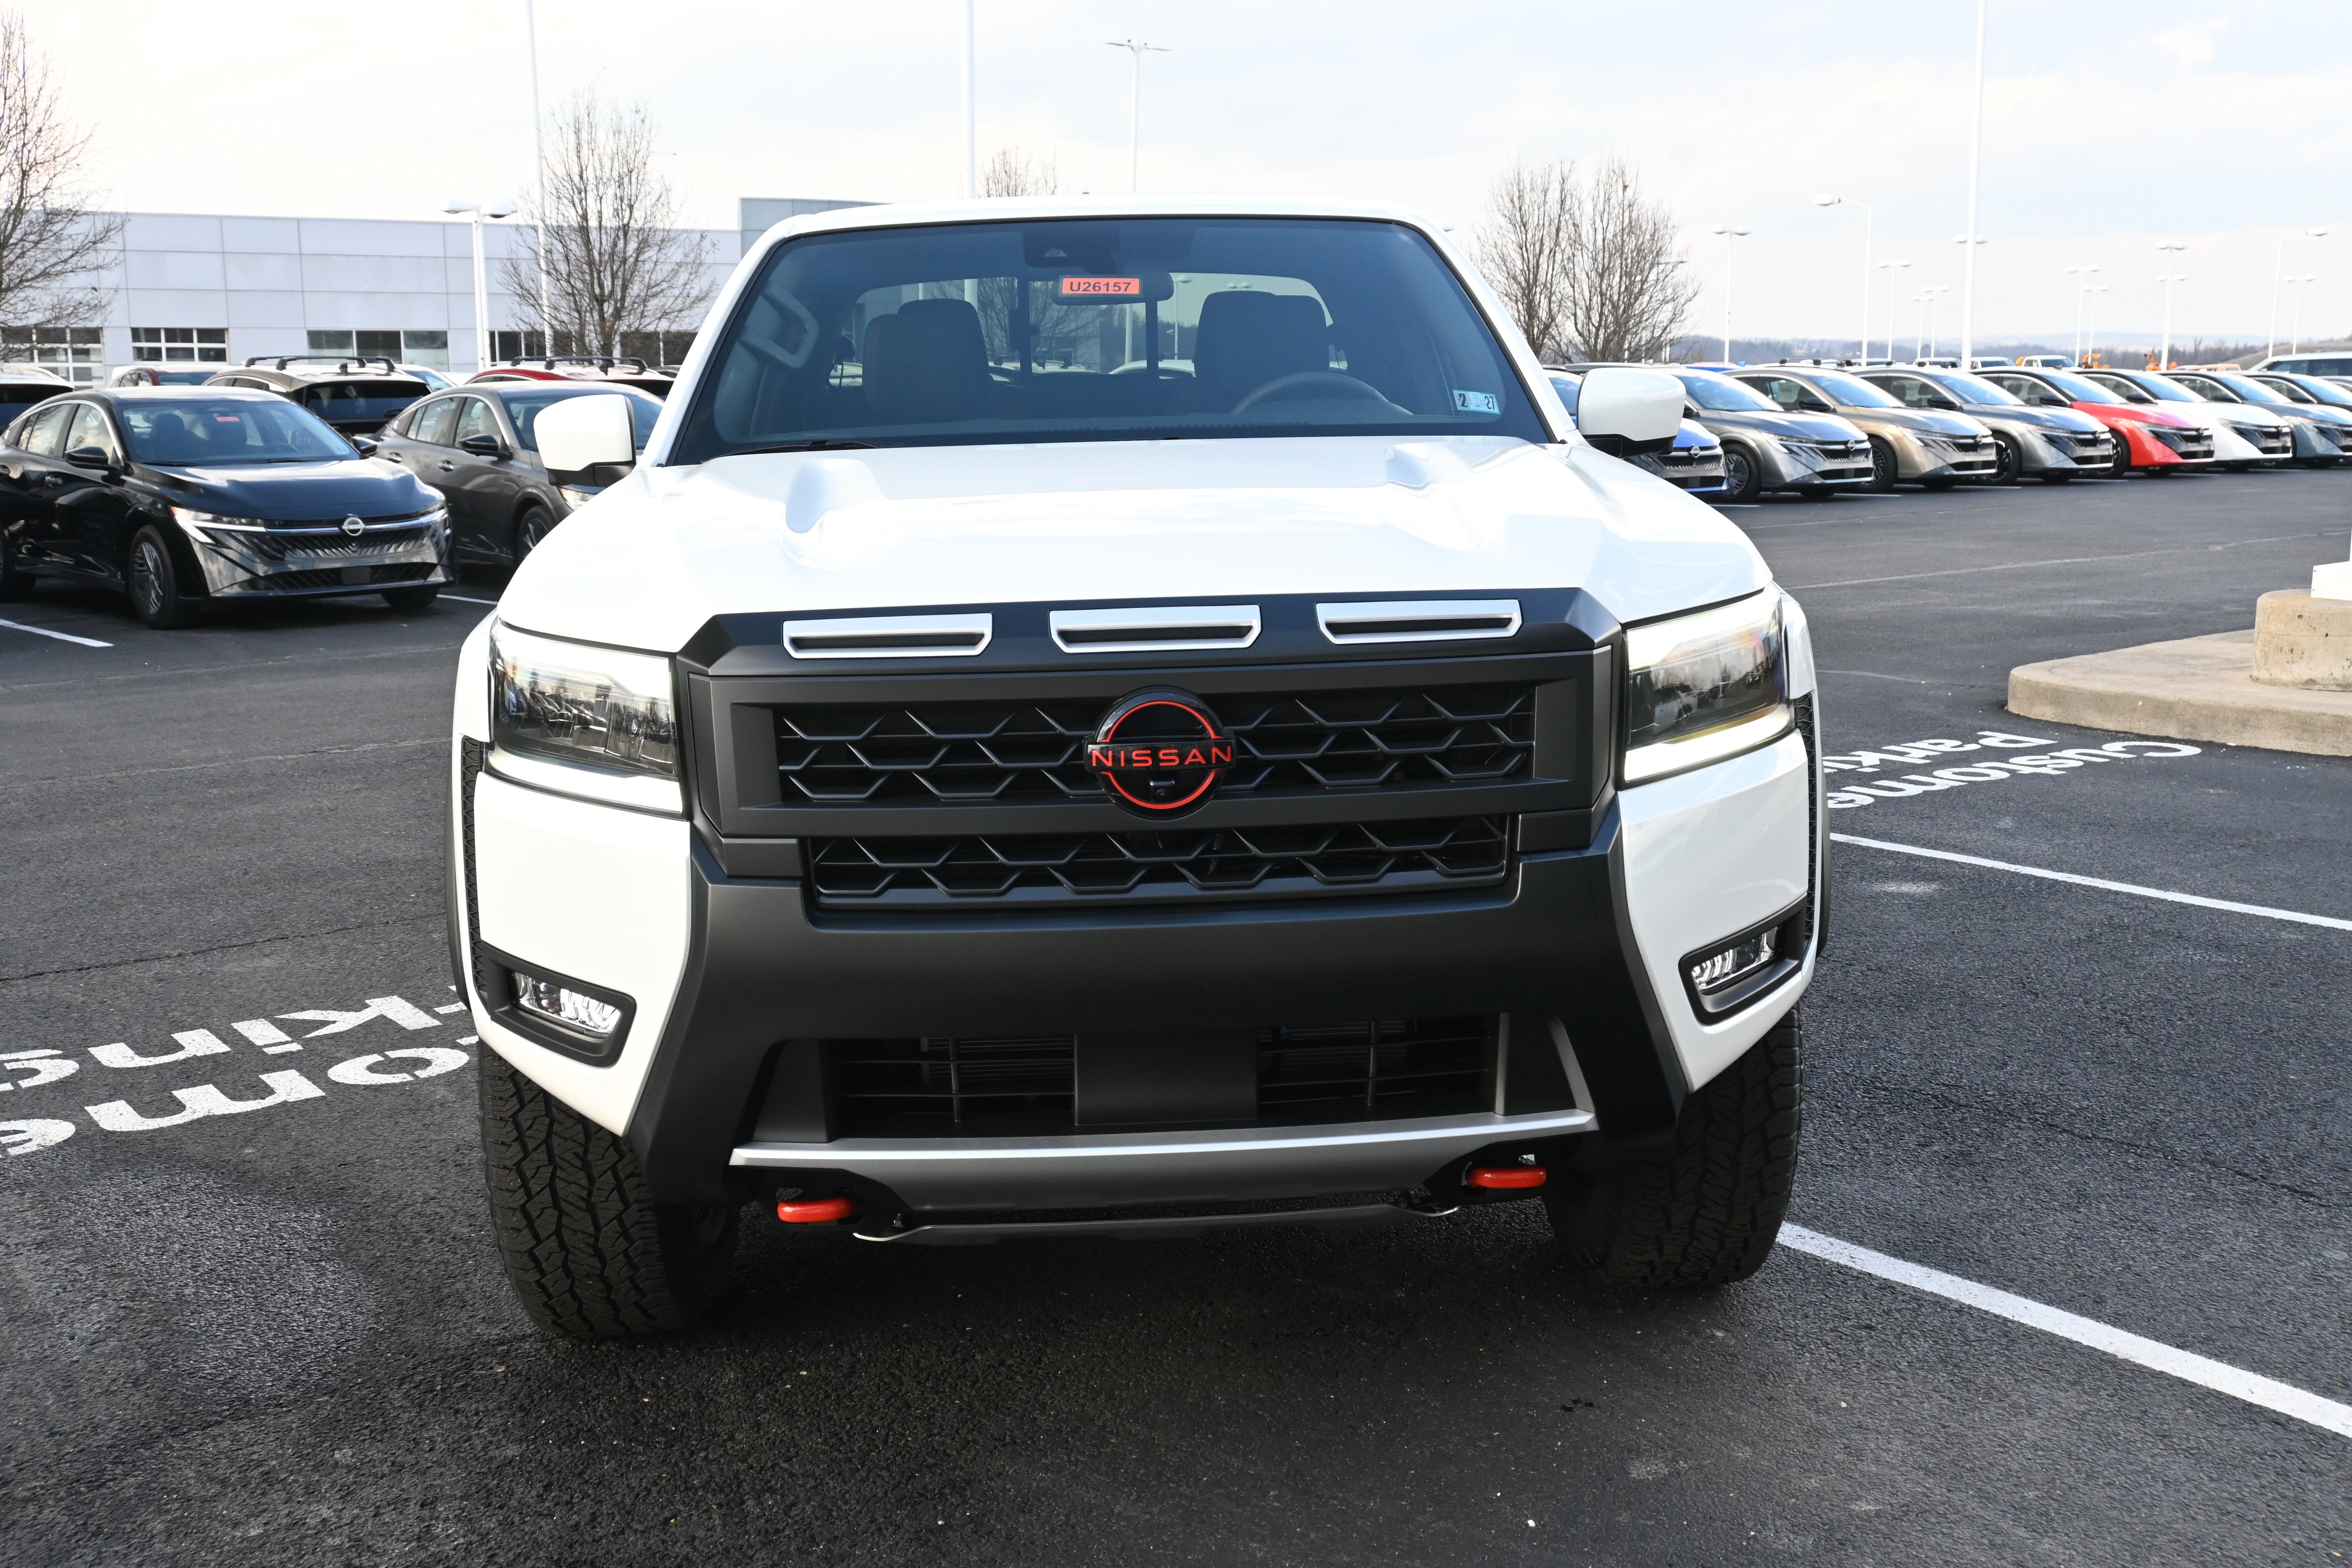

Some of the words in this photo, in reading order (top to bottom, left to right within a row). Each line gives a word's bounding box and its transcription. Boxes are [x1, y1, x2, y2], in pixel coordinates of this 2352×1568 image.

[1070, 282, 1131, 292] U26157
[1459, 393, 1468, 407] 2
[1484, 396, 1495, 411] 27
[1092, 746, 1231, 767] NISSAN
[1823, 731, 2058, 773] Parki
[0, 1036, 479, 1158] ome
